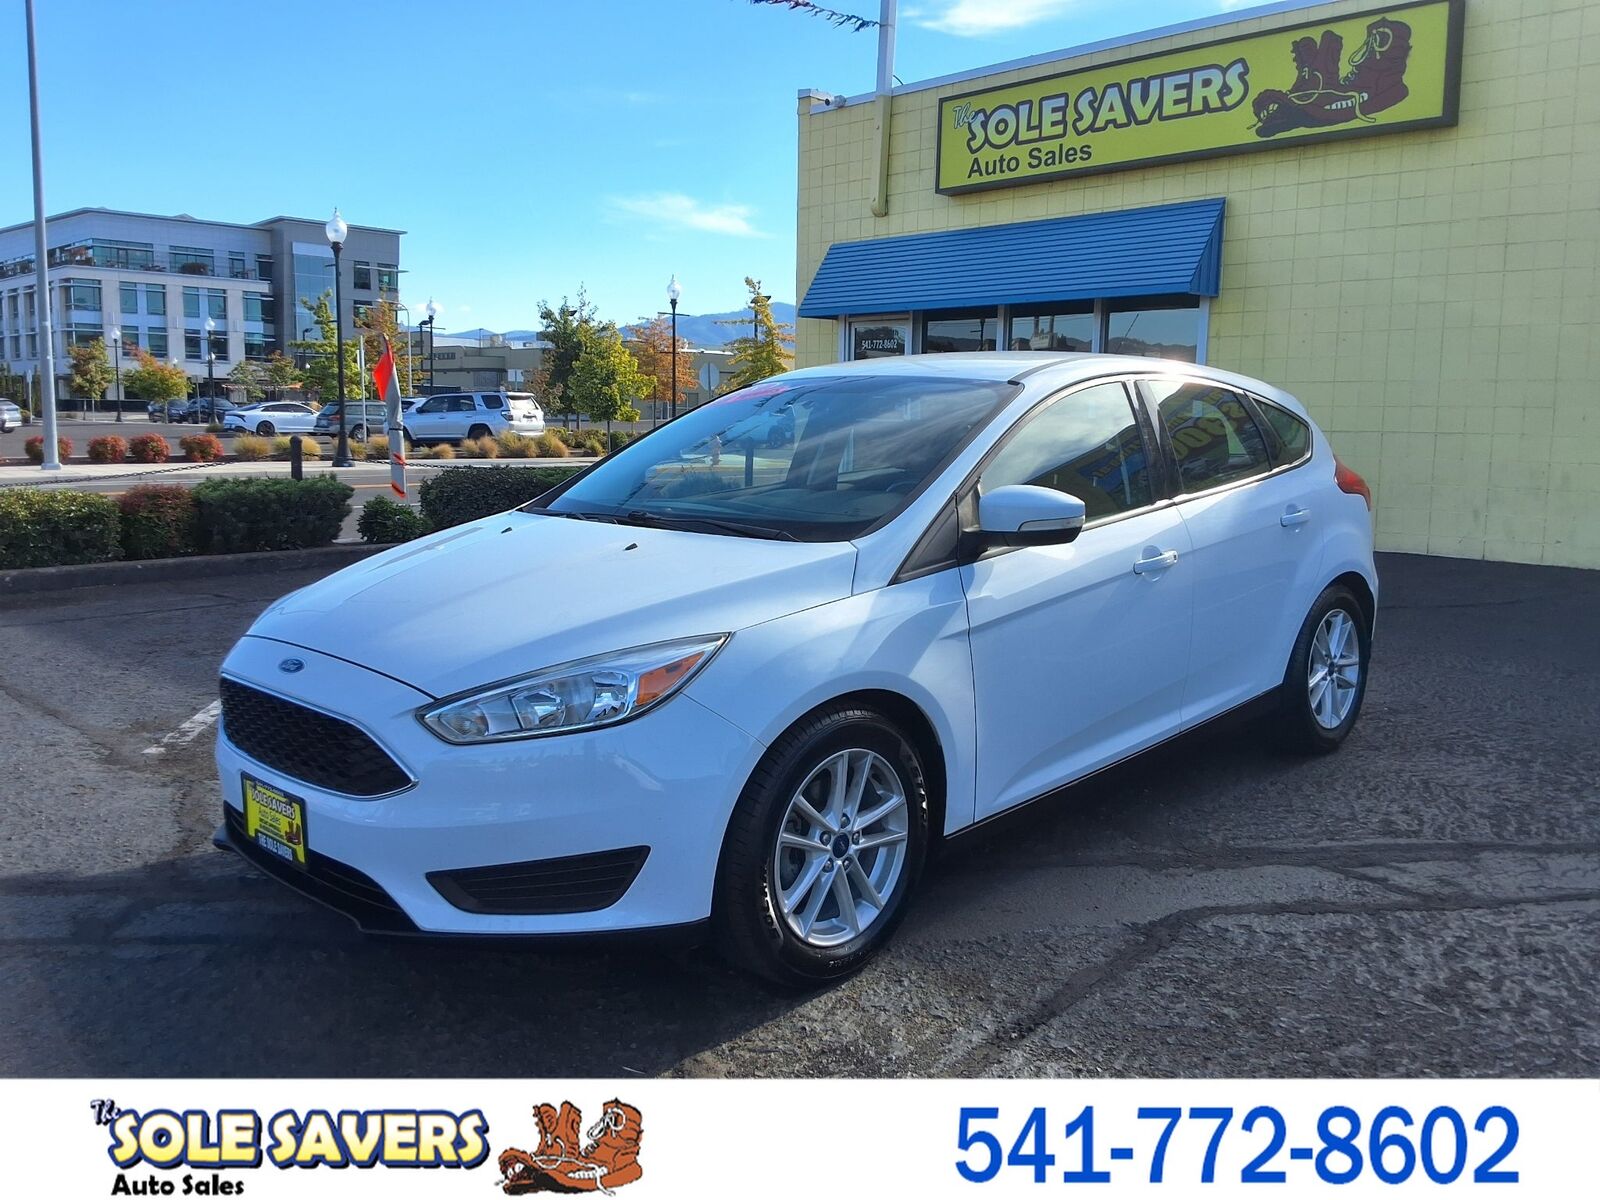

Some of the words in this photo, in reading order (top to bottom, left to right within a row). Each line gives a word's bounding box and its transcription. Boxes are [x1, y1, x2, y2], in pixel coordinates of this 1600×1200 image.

[953, 101, 978, 131] The
[967, 92, 1069, 153] SOLE
[1072, 59, 1249, 136] SAVERS
[967, 150, 1021, 179] Auto
[1028, 141, 1093, 171] Sales
